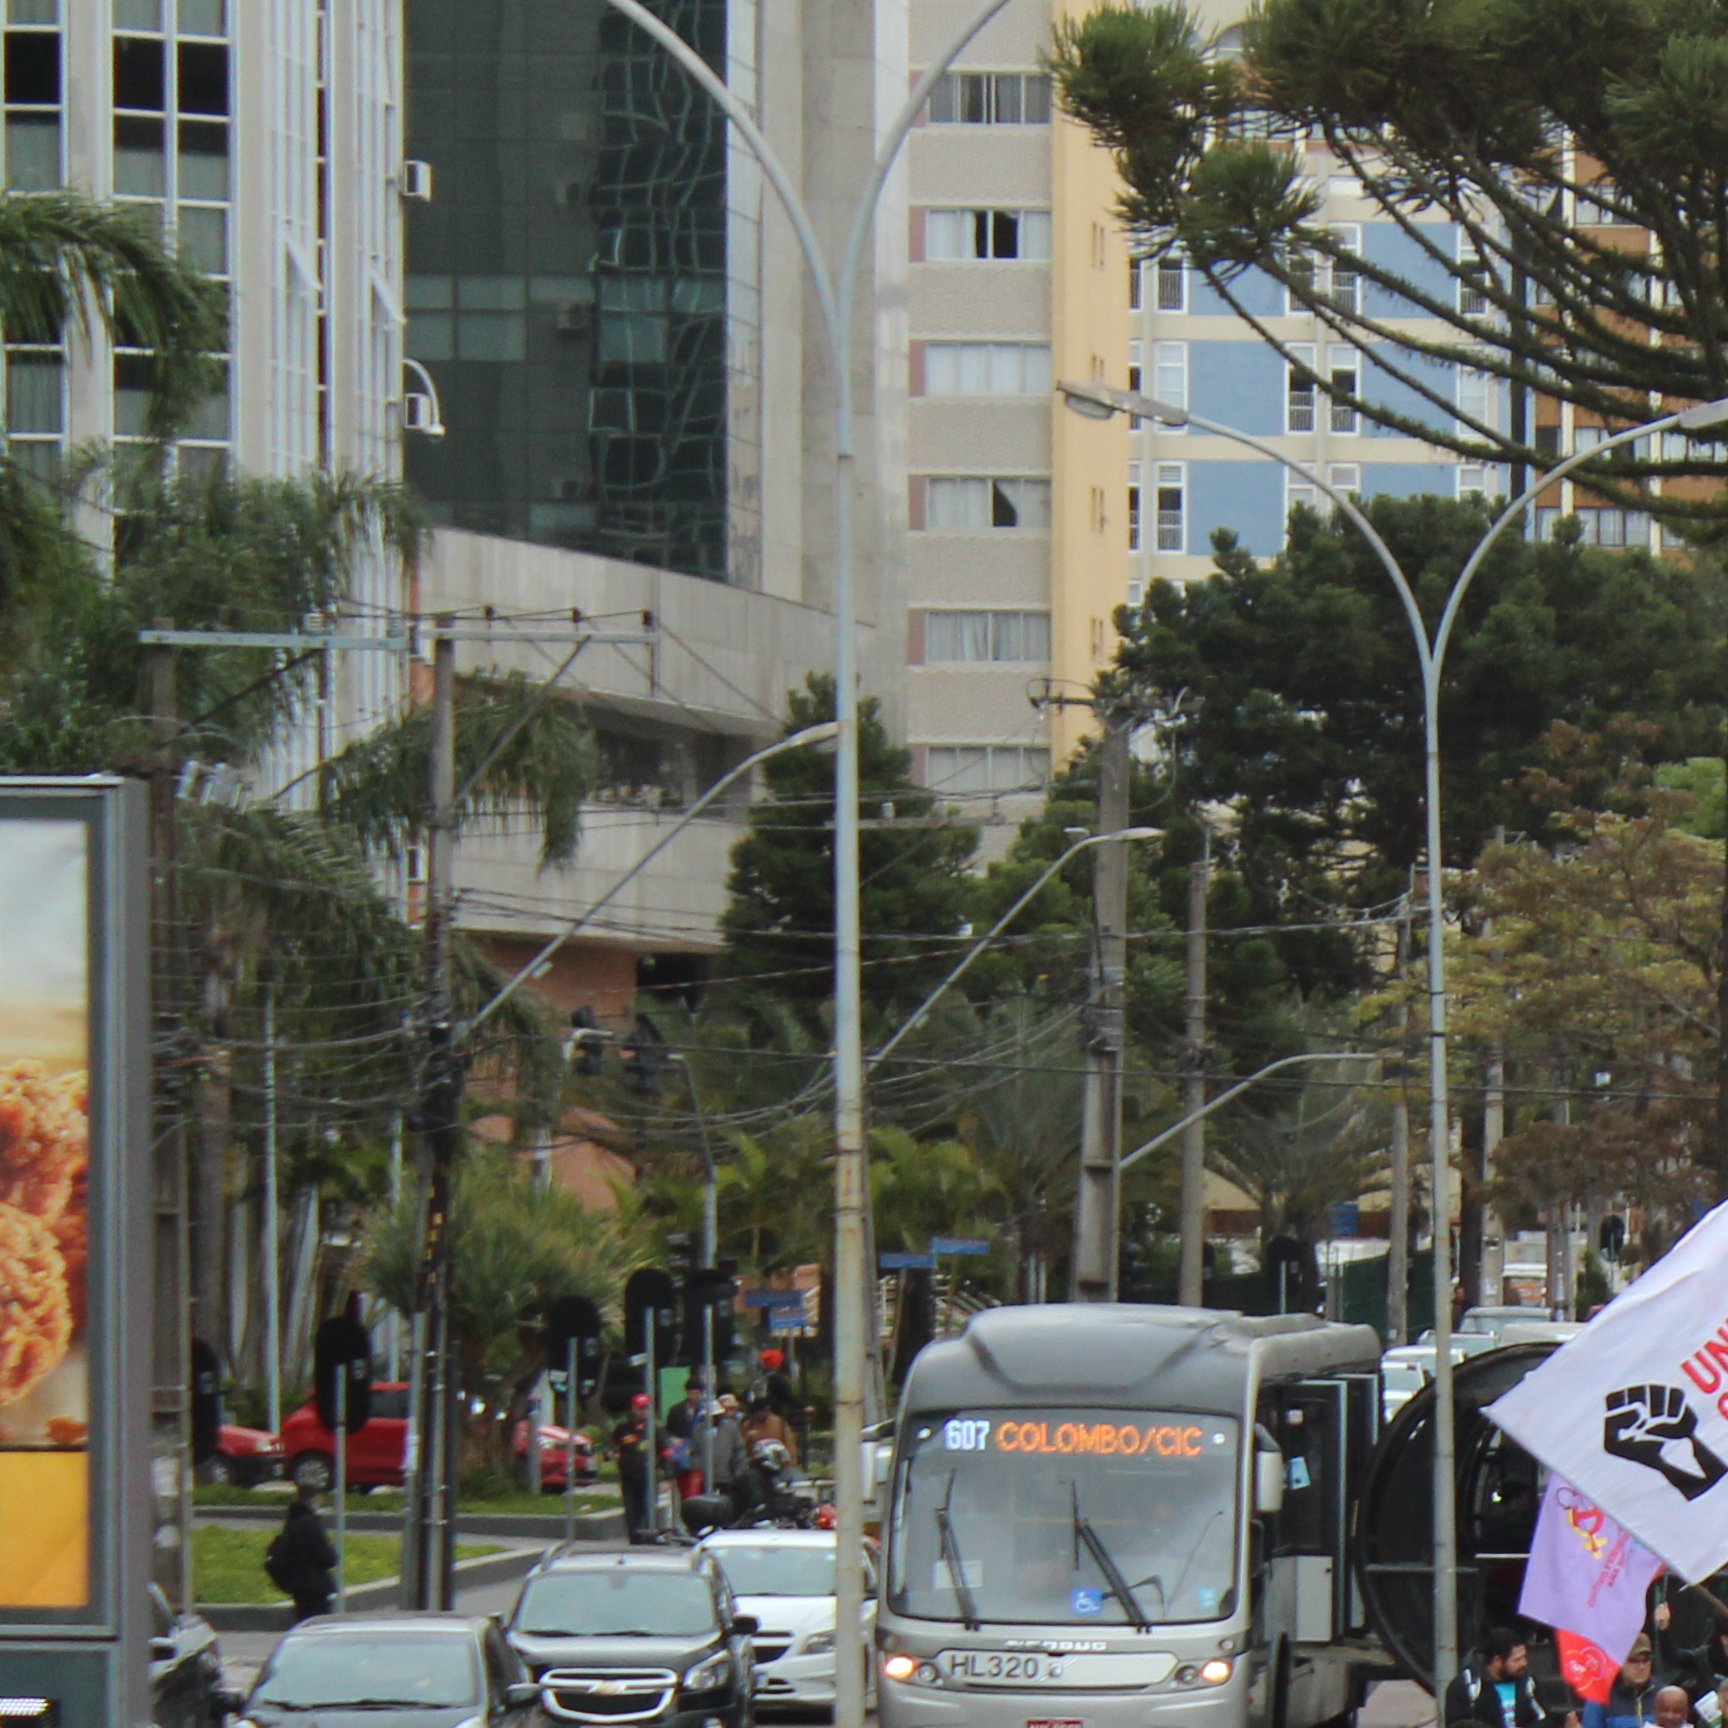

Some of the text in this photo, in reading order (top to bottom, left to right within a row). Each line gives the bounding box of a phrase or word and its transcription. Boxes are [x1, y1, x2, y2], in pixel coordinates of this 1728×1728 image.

[944, 1419, 1203, 1457] 607 COLOMBO/CIC
[951, 1655, 1038, 1679] HL320
